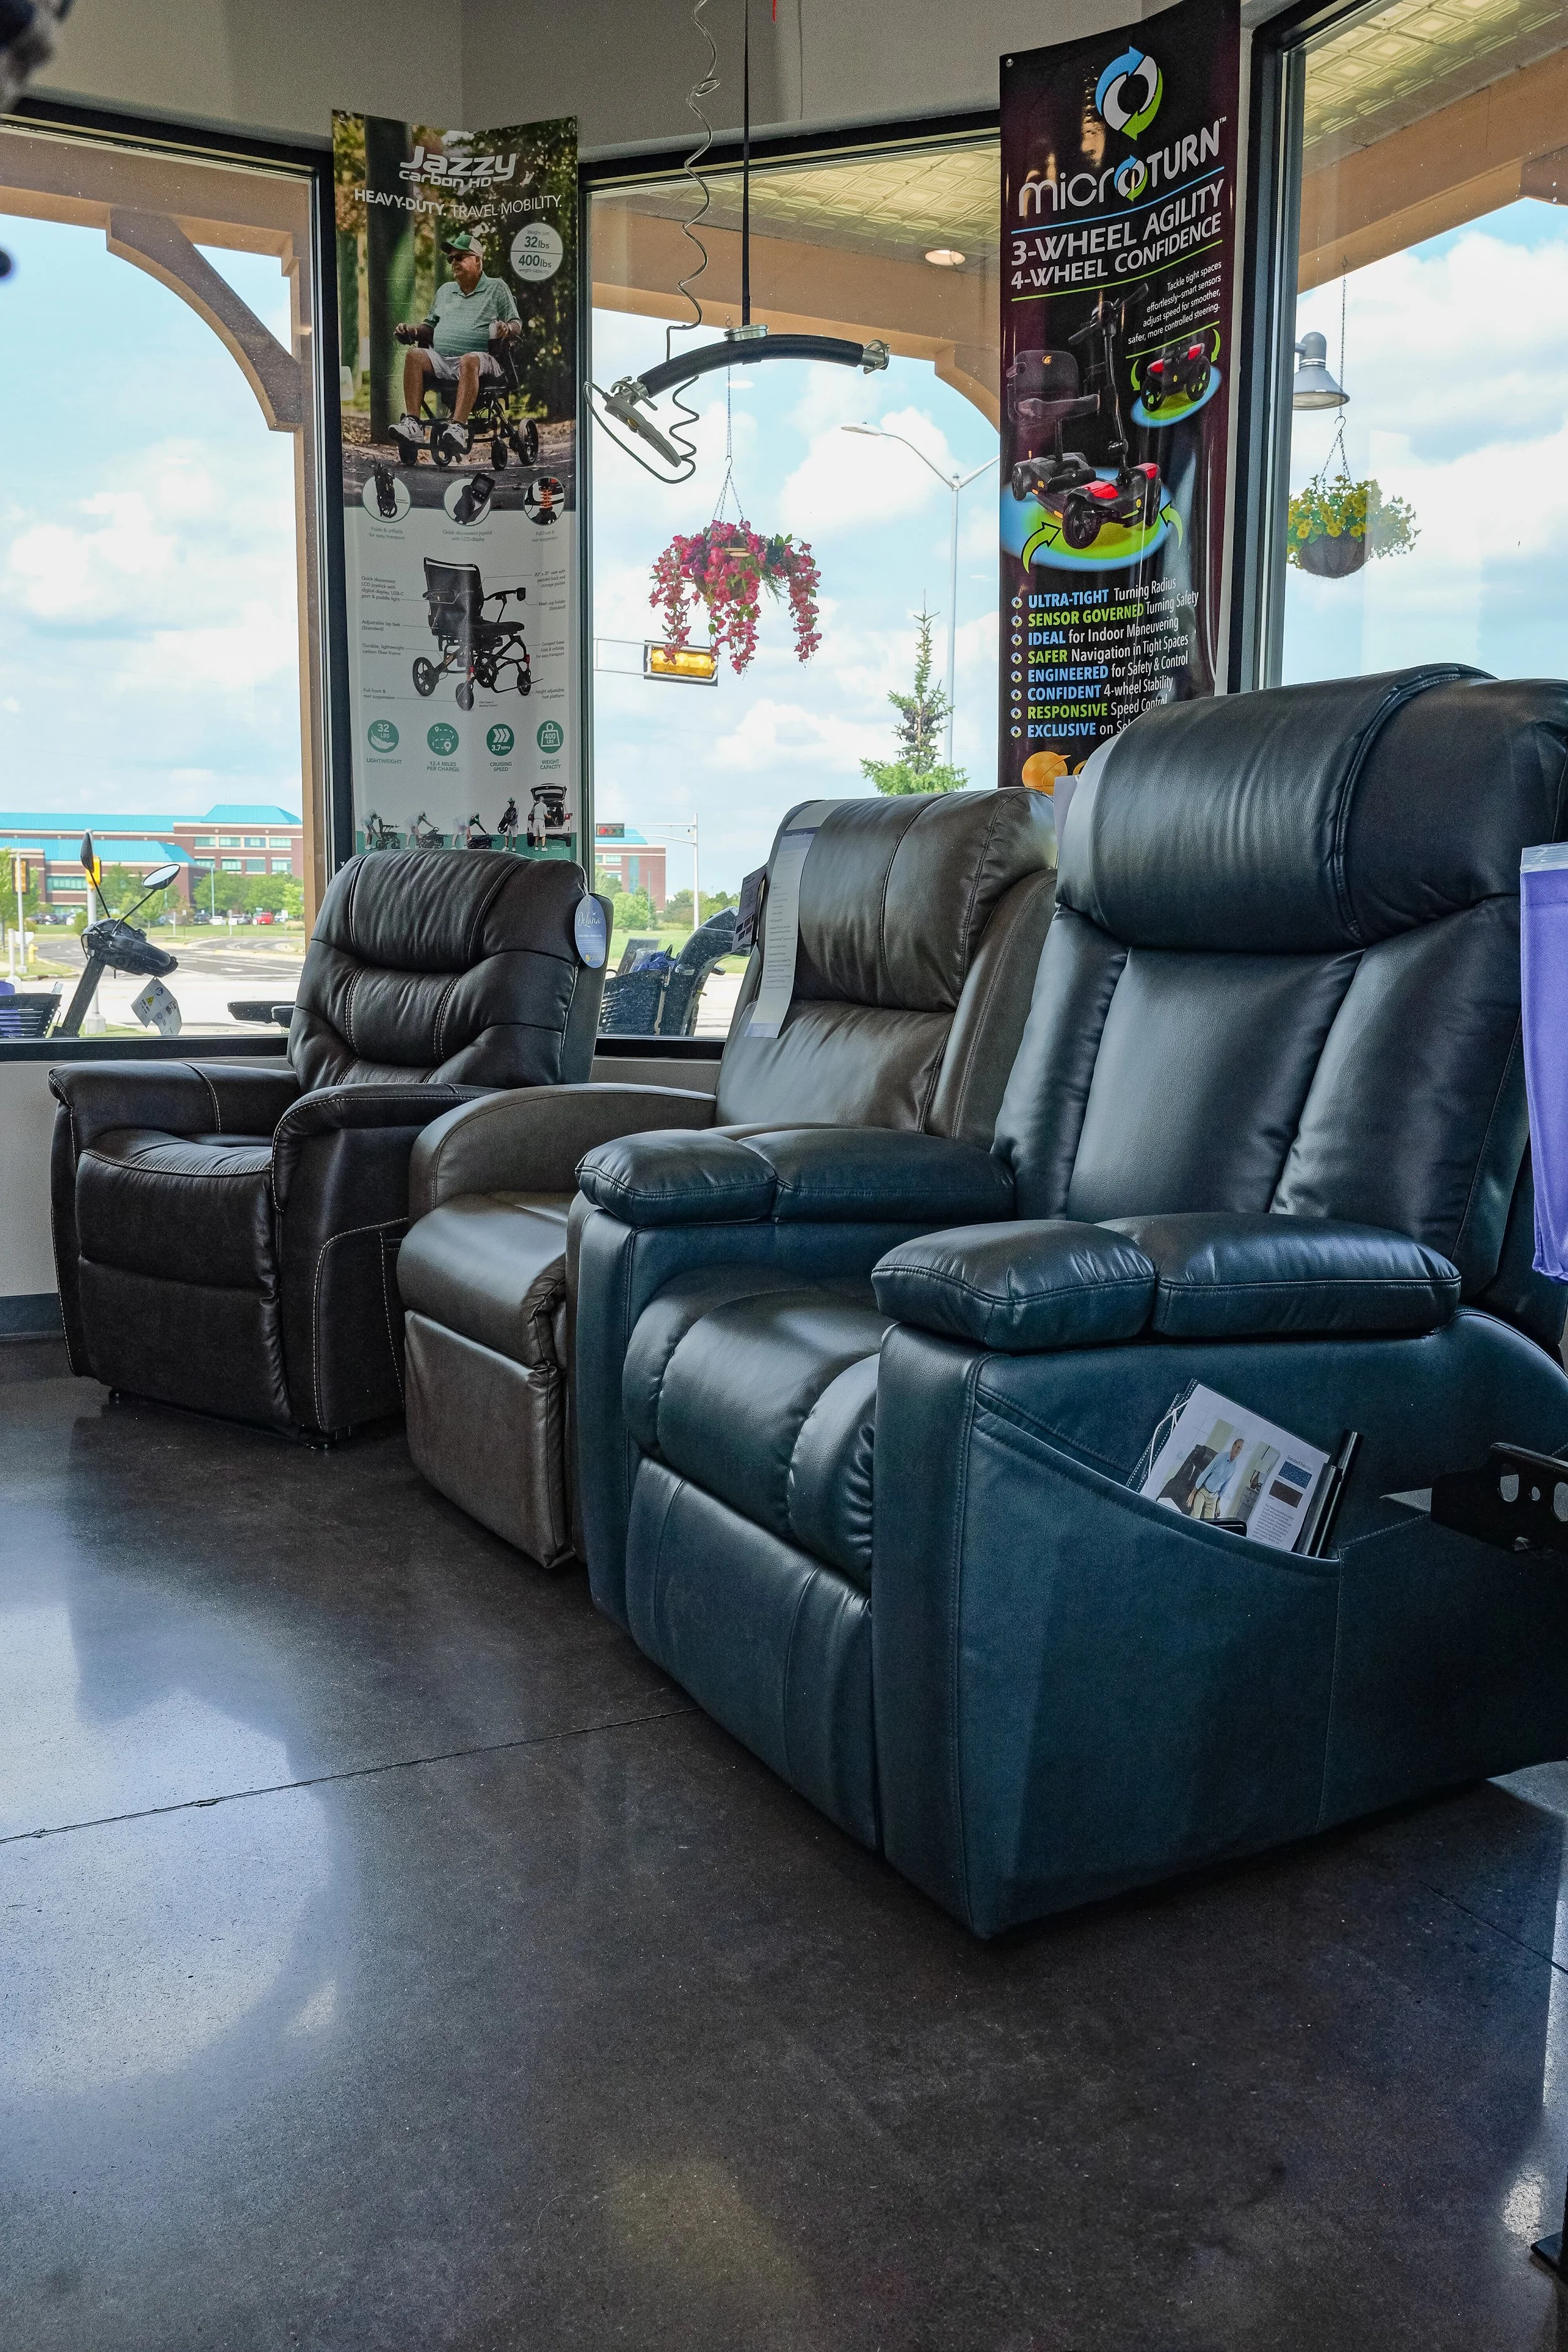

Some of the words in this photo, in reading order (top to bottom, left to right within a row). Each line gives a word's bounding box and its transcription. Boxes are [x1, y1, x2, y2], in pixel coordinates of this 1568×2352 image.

[399, 169, 464, 188] carbon
[469, 176, 492, 188] HD
[400, 146, 517, 181] Jazzy
[354, 188, 447, 216] HEAVY-DUTY.
[450, 204, 499, 219] TRAVEL
[500, 194, 563, 216] MOBILITY.
[1011, 221, 1136, 266] 3-WHEEL
[1143, 178, 1224, 241] AGILITY
[1011, 259, 1108, 290] 4-WHEEL
[1115, 212, 1222, 273] CONFIDENCE
[1167, 277, 1185, 292] Tackle
[1186, 270, 1200, 283] tight
[1200, 262, 1222, 277] spaces
[1198, 275, 1222, 290] sensors
[1143, 314, 1162, 327] adjust
[1163, 304, 1180, 321] speed
[1182, 302, 1190, 311] for
[1190, 289, 1221, 307] smoother,
[1128, 332, 1147, 344] safer,
[1147, 327, 1163, 339] more
[1164, 311, 1193, 332] controlled
[1194, 303, 1221, 319] steering.
[1027, 588, 1109, 608] ULTRA-TIGHT
[1113, 585, 1149, 601] Turning
[1151, 576, 1177, 594] Radius
[1027, 610, 1079, 627] SENSOR
[1083, 603, 1144, 624] GOVERNED
[1146, 597, 1175, 615] Turning
[1176, 590, 1199, 607] Safety
[1028, 630, 1066, 645] IDEAL
[1068, 628, 1085, 644] for
[1088, 627, 1125, 643] Indoor
[1126, 617, 1179, 638] Maneuvering
[1027, 649, 1067, 664] SAFER
[1071, 644, 1130, 664] Navigation
[1133, 643, 1141, 656] in
[1143, 638, 1162, 657] Tight
[1163, 634, 1189, 653] Spaces
[1028, 665, 1109, 682] ENGINEERED
[1111, 662, 1126, 678] for
[1127, 660, 1152, 676] Safety
[1153, 657, 1160, 671] &
[1161, 650, 1188, 669] Control
[1027, 684, 1101, 701] CONFIDENT
[1103, 679, 1142, 697] 4-wheel
[1143, 674, 1173, 692] Stability
[1027, 703, 1108, 719] RESPONSIVE
[1110, 698, 1139, 719] Speed
[378, 723, 389, 733] 32
[1027, 722, 1096, 738] EXCLUSIVE
[1099, 724, 1113, 735] on
